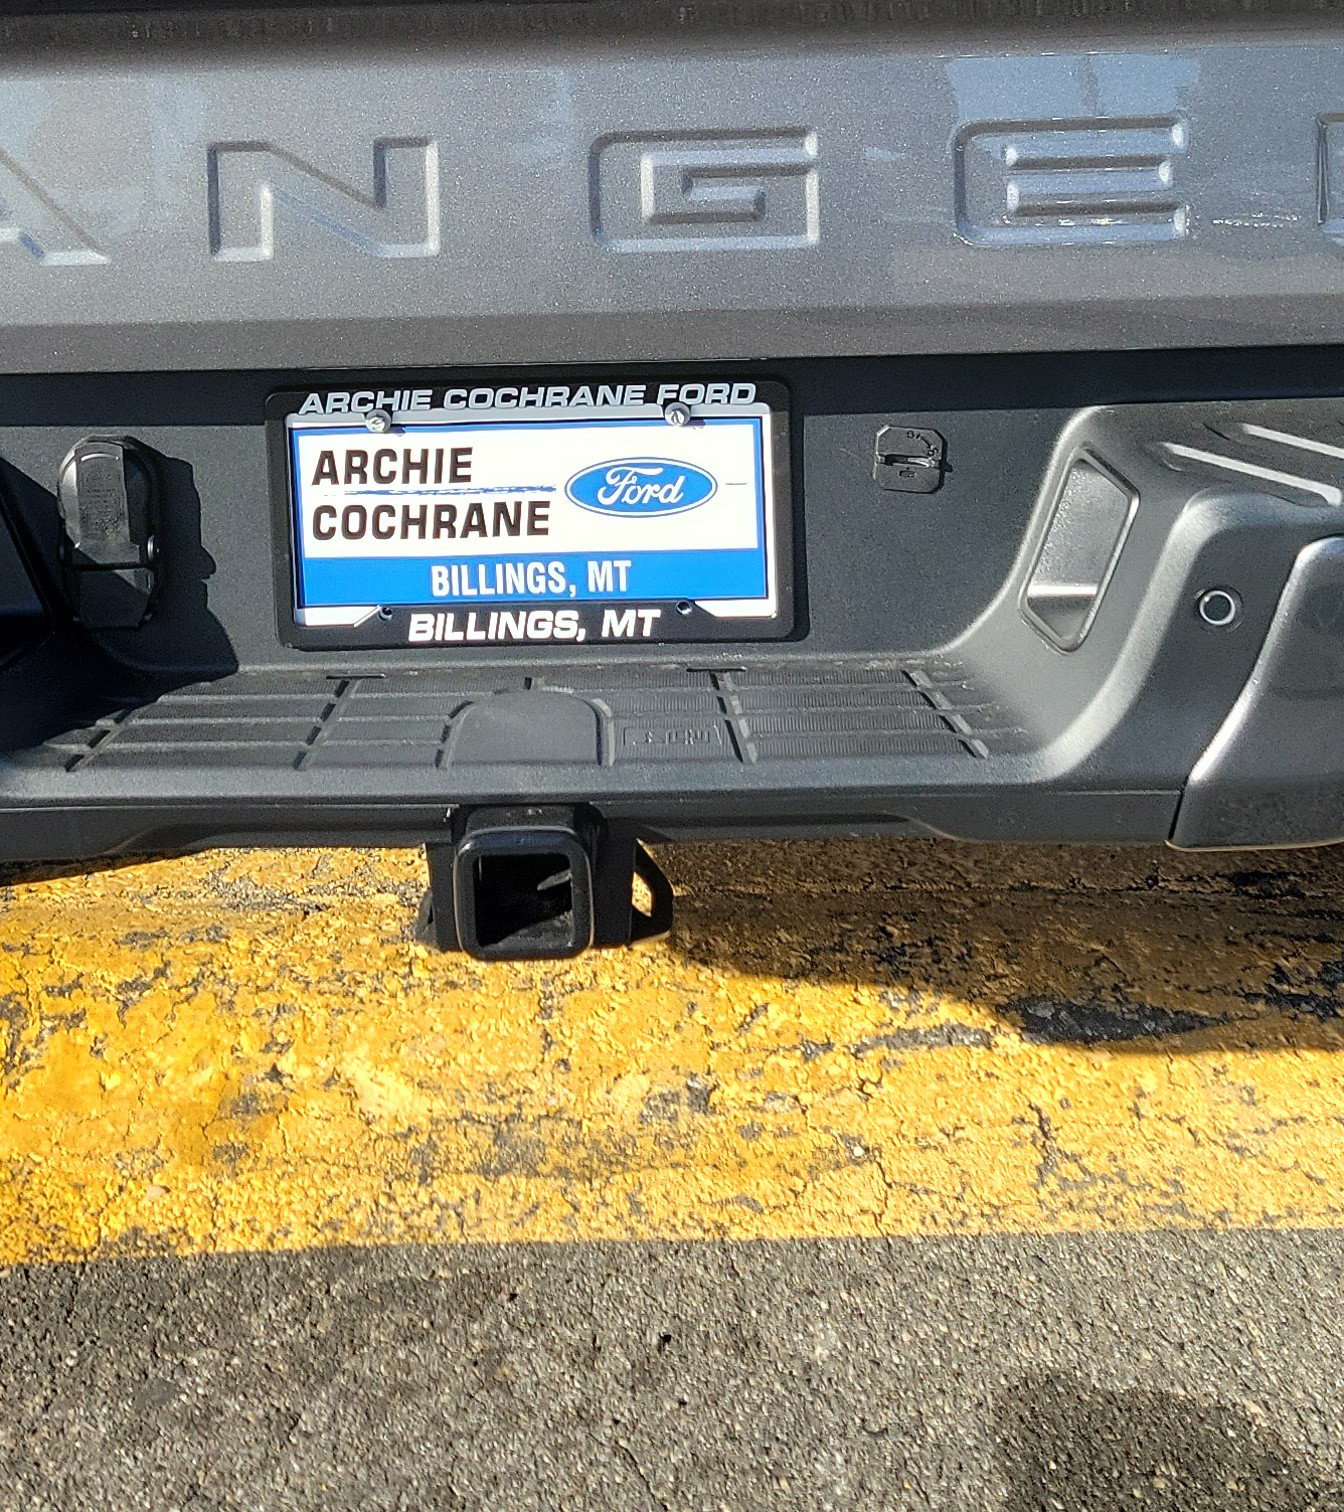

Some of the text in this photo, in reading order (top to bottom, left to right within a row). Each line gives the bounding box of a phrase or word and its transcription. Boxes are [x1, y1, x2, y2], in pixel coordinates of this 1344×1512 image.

[298, 383, 756, 414] ARCHIE COCHRANE FORD
[311, 447, 474, 486] ARCHIE
[596, 466, 684, 506] Ford
[311, 500, 551, 541] COCHRANE
[430, 560, 632, 598] BILLINGS, MT
[408, 609, 661, 643] BILLINGS, MT
